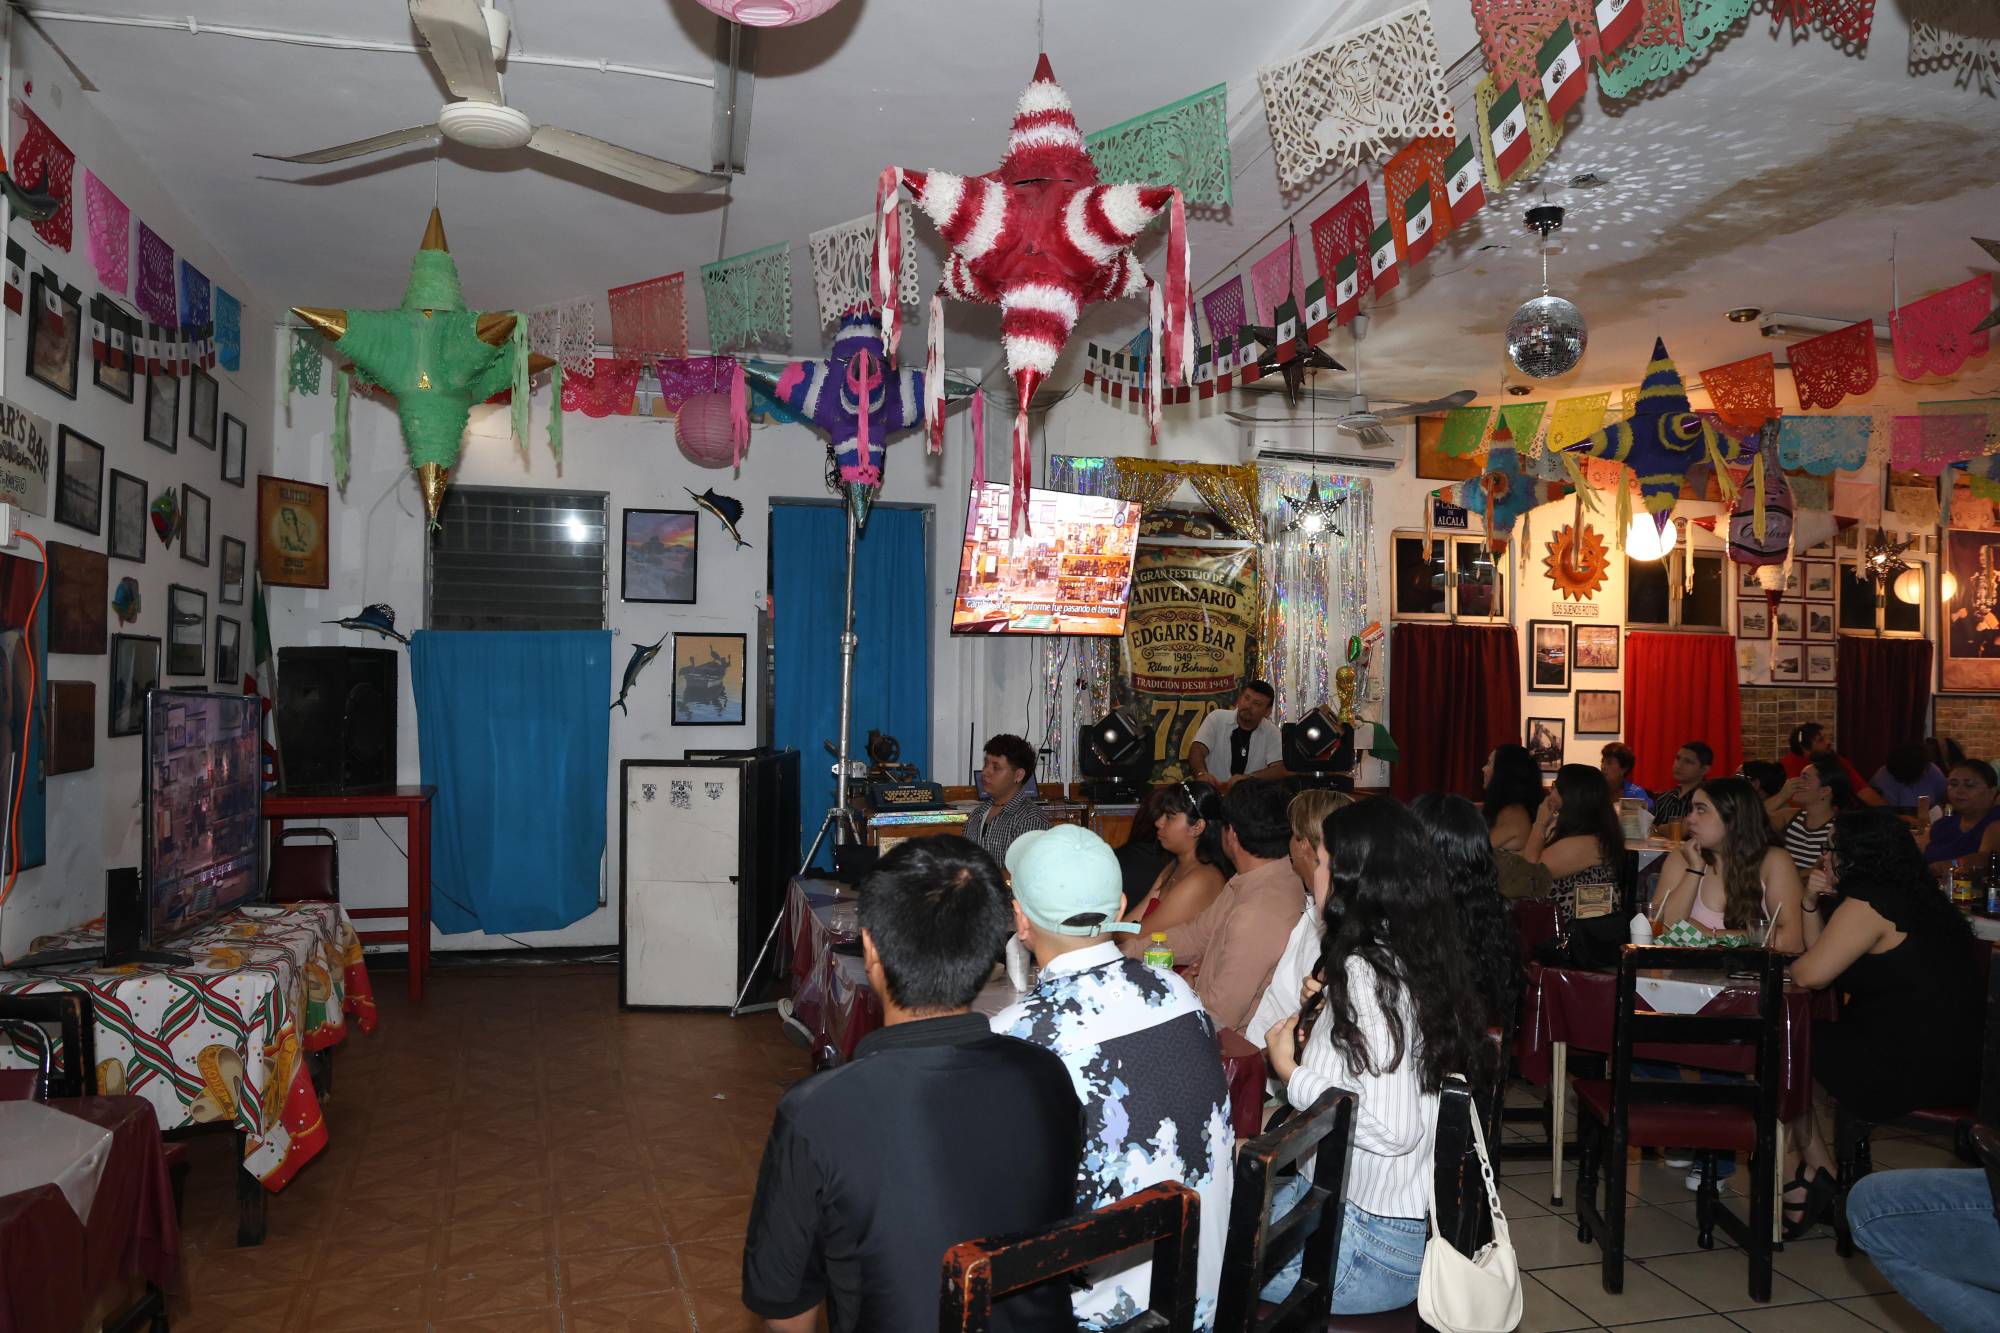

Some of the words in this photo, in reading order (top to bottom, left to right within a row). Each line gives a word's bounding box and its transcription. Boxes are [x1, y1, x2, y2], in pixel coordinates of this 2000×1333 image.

[27, 422, 49, 485] BAR
[1140, 568, 1167, 582] GRAN
[1169, 568, 1209, 581] FESTEJO
[1212, 574, 1225, 585] DE
[1133, 586, 1237, 609] ANIVERSARIO
[1052, 602, 1063, 612] fue
[1063, 604, 1091, 614] pasando
[1131, 623, 1199, 648] EDGAR'S
[1202, 626, 1235, 652] BAR
[1173, 652, 1193, 662] 1949
[1173, 665, 1180, 674] y
[1181, 661, 1219, 673] Bohemia
[1182, 681, 1208, 690] DESDE
[1209, 678, 1229, 690] 1949
